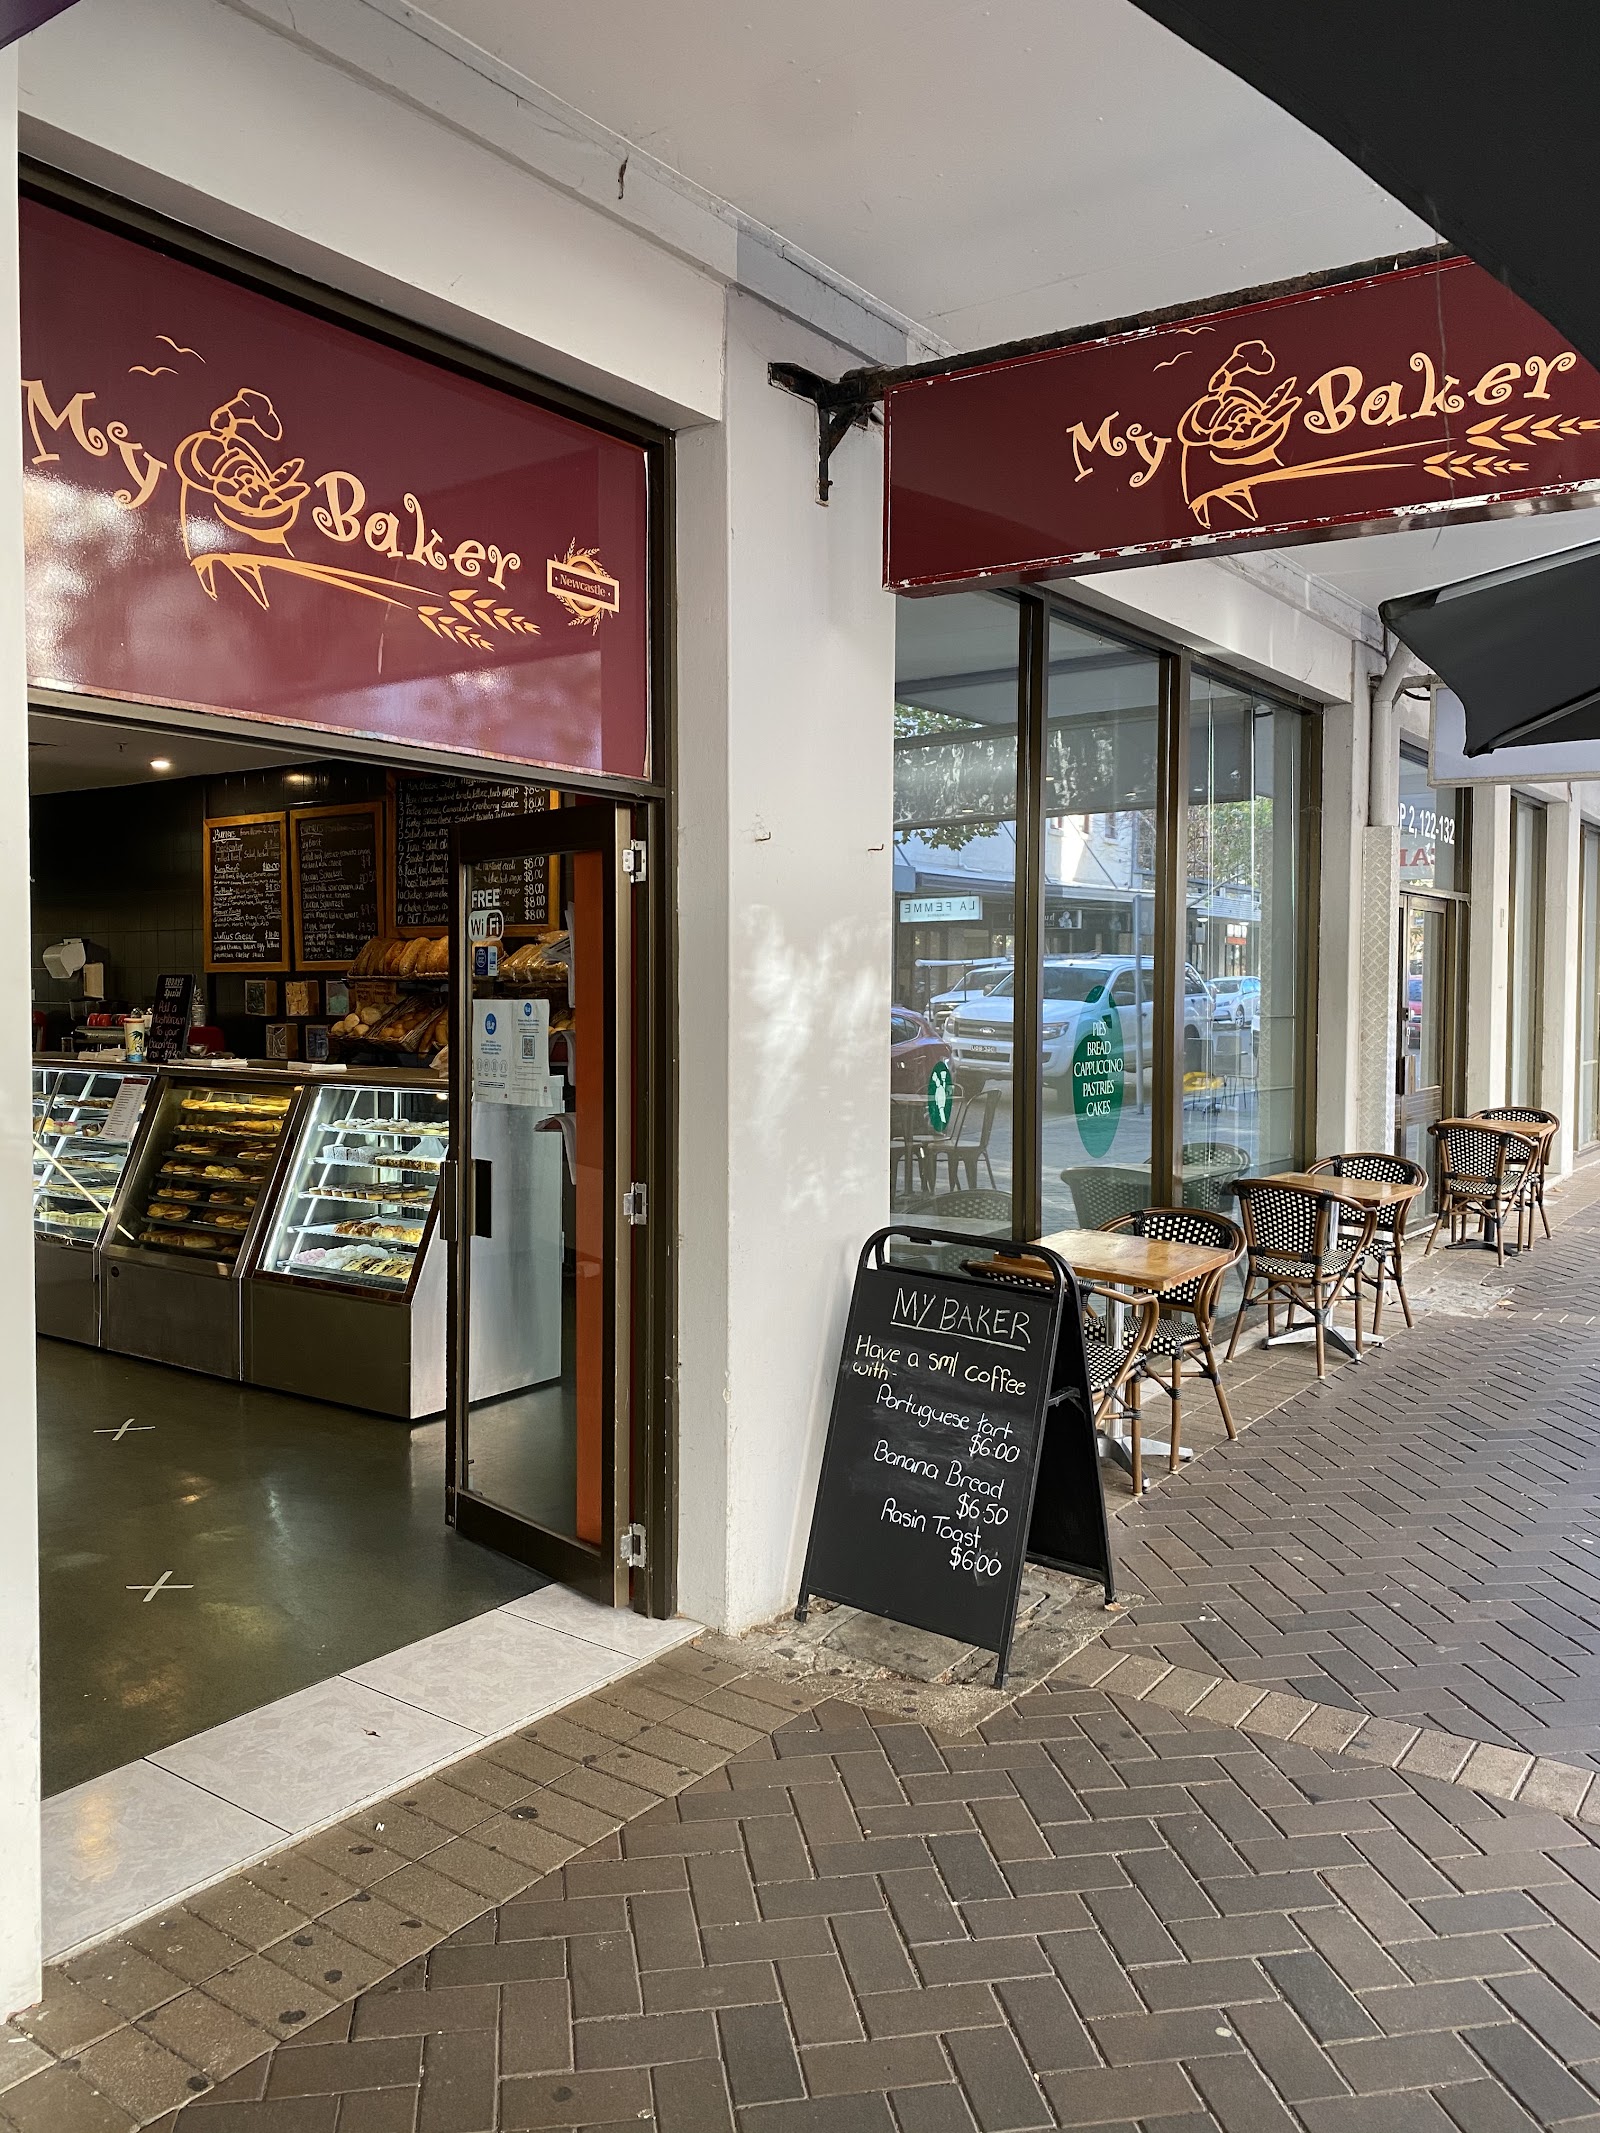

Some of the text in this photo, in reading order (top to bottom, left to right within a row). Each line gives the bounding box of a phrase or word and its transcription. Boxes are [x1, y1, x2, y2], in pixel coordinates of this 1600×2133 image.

[1066, 351, 1577, 488] My Baker
[21, 379, 521, 591] My Baker
[560, 574, 606, 597] Newcastle
[1420, 810, 1455, 845] 122-132
[471, 889, 501, 909] FREE
[524, 882, 545, 895] $8.00
[524, 895, 546, 909] $8.00
[524, 909, 545, 921] $8.00
[213, 931, 234, 941] Julius
[1092, 1021, 1107, 1036] PIES
[1087, 1041, 1112, 1056] BREAD
[1073, 1058, 1124, 1077] CAPPUCCINO
[1083, 1080, 1115, 1097] PASTRIES
[1086, 1100, 1111, 1117] CAKES
[892, 1287, 1031, 1344] MY BAKER
[855, 1335, 900, 1363] Have
[907, 1352, 919, 1368] a
[876, 1384, 1013, 1440] Portuguese tart
[969, 1433, 1021, 1463] $6.00
[873, 1439, 1005, 1500] Banana Bread
[956, 1492, 1009, 1525] $6.50
[881, 1497, 982, 1549] Rasin Toast
[949, 1542, 1002, 1577] $6.00
